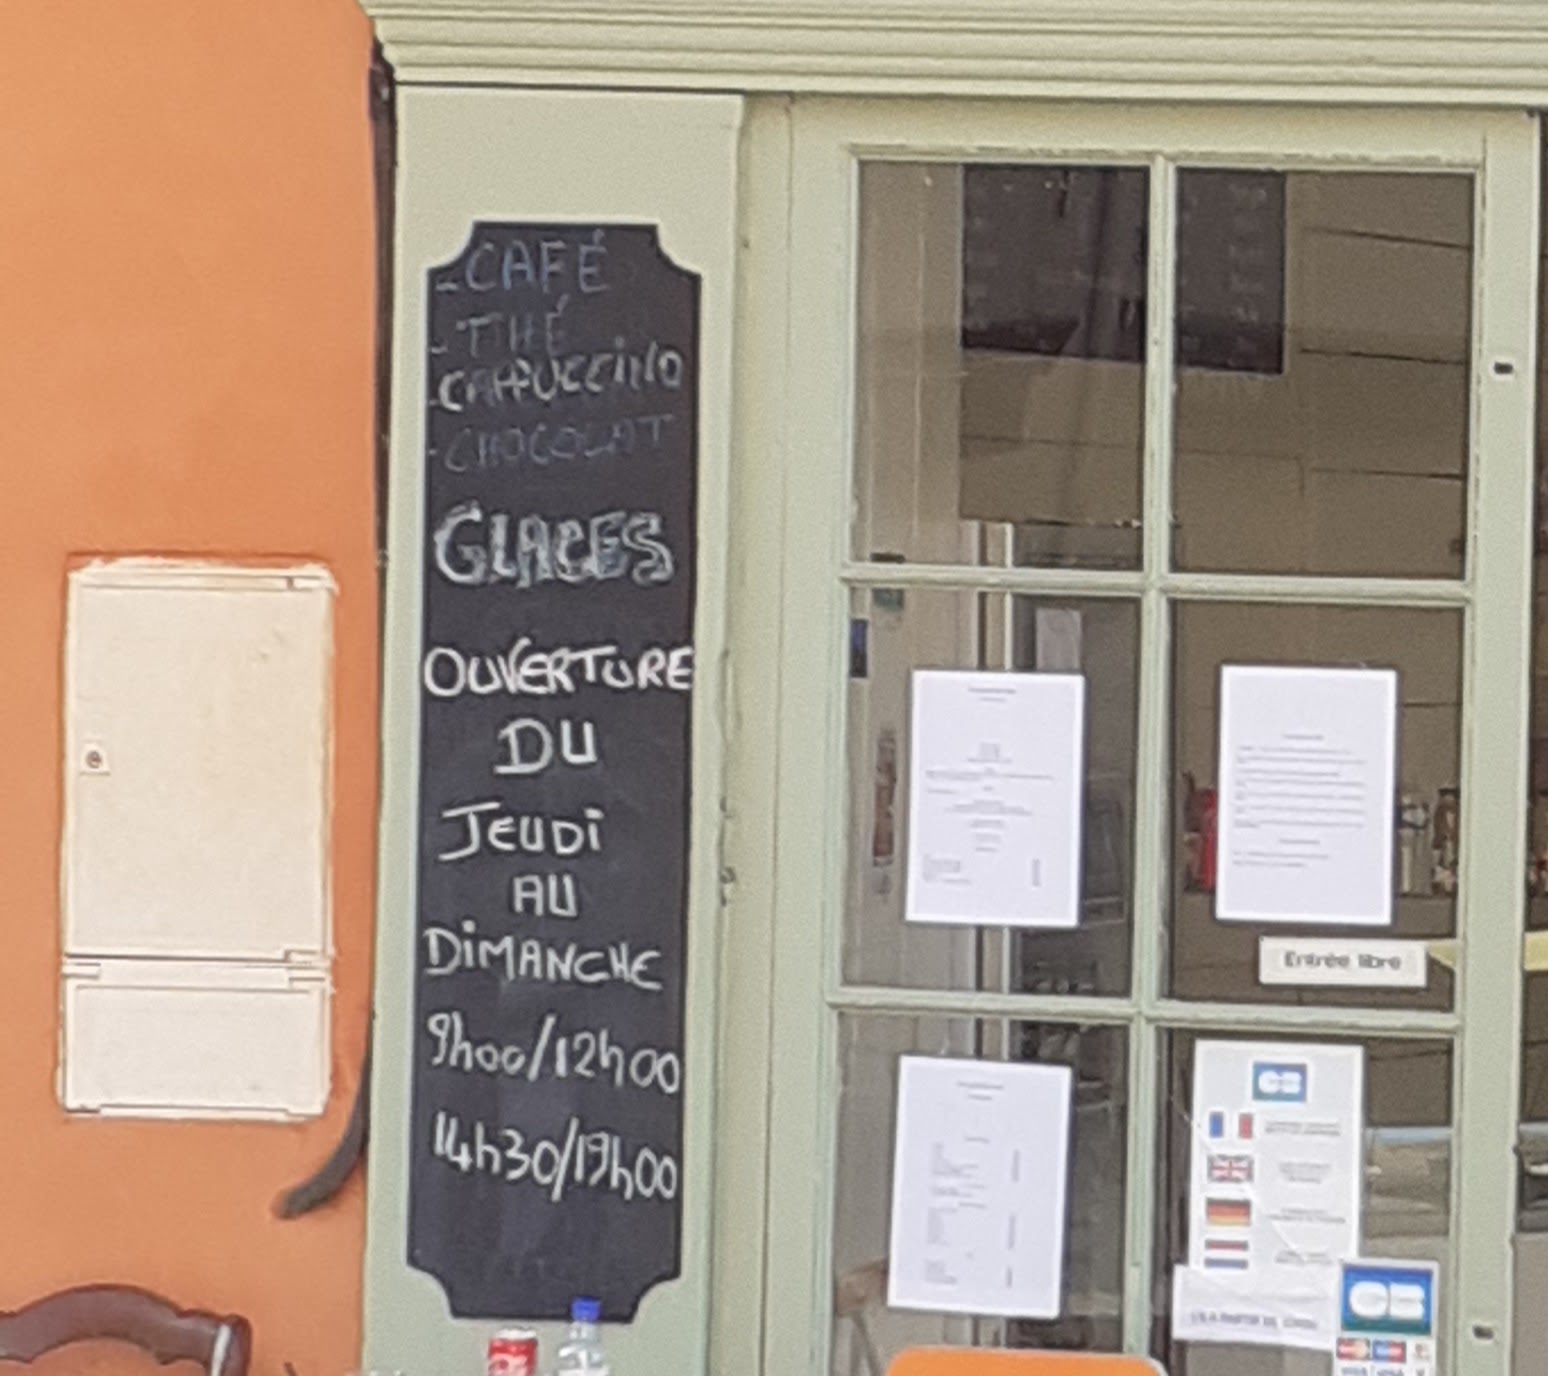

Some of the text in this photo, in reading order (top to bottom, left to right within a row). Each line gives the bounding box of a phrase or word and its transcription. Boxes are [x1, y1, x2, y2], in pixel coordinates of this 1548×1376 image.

[464, 228, 609, 293] CAFÉ
[455, 294, 569, 358] THÉ
[433, 501, 676, 587] GLACES
[423, 636, 693, 697] OUVERTURE
[493, 717, 599, 776] DU
[512, 872, 579, 918] AU
[1284, 950, 1401, 971] Entrée libre
[427, 1012, 681, 1094] 9h00/12h00
